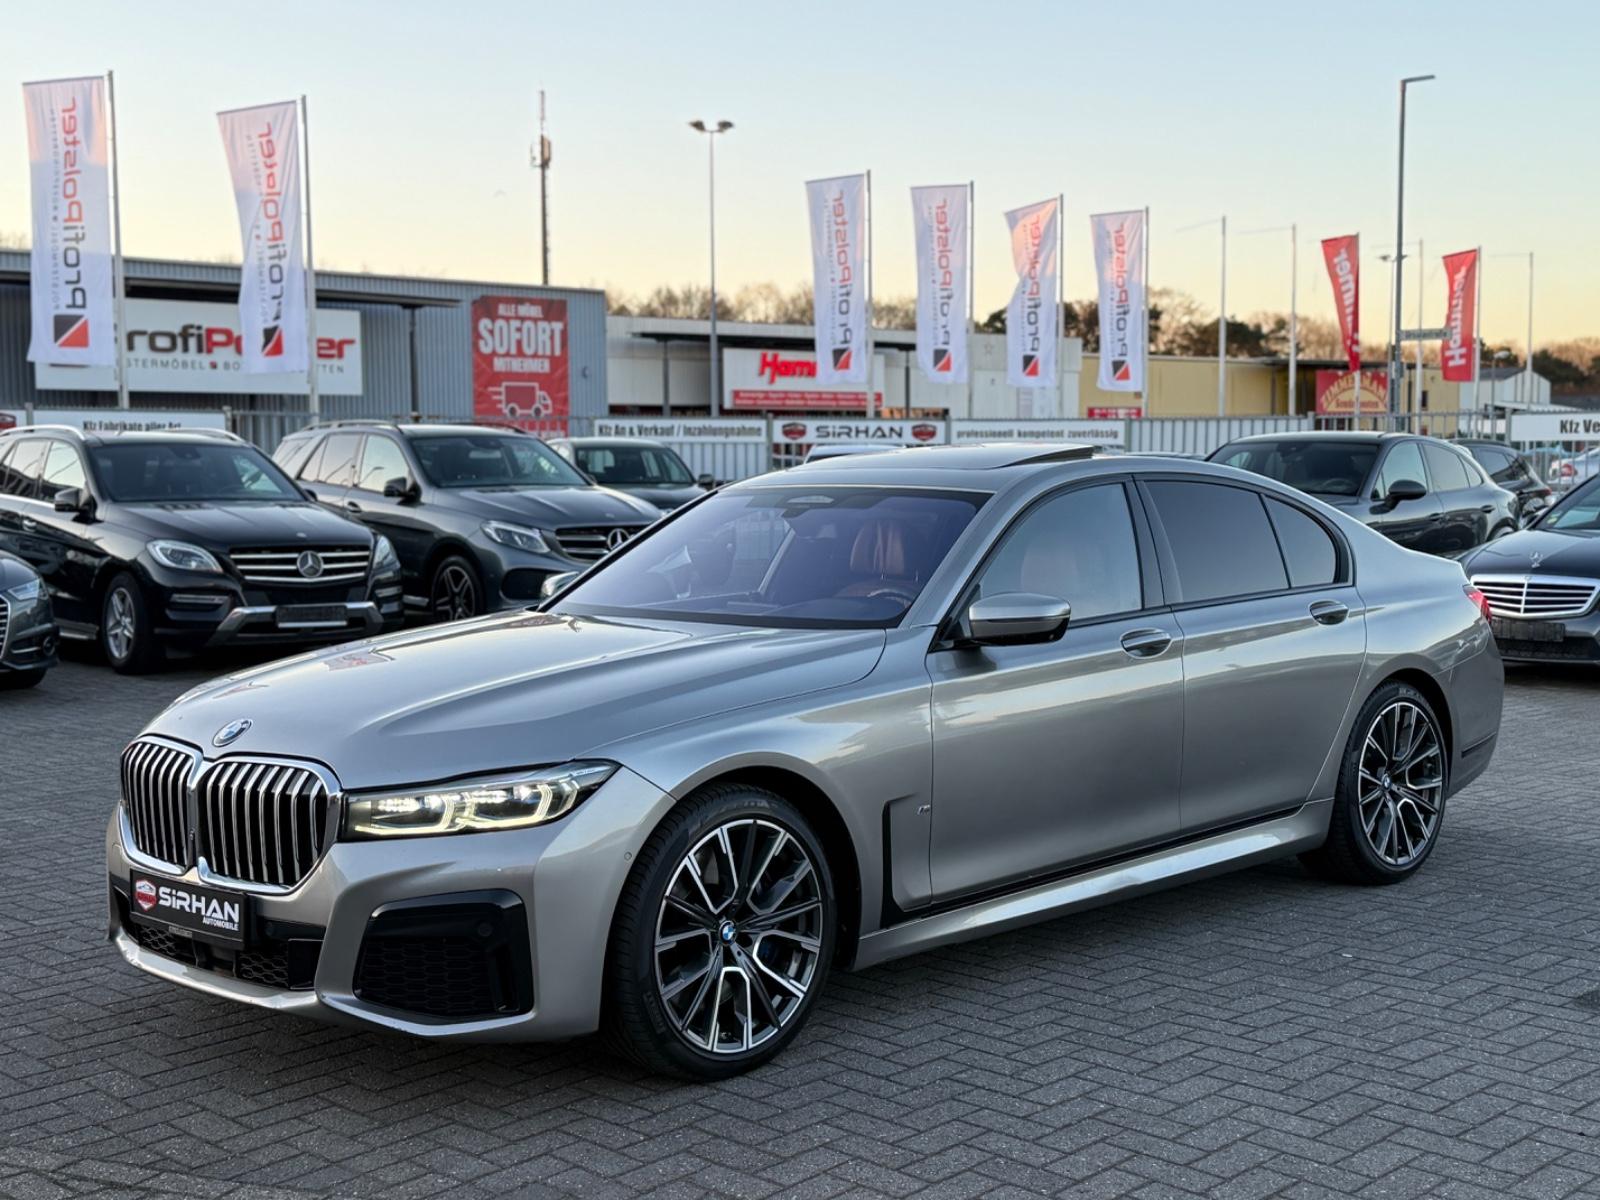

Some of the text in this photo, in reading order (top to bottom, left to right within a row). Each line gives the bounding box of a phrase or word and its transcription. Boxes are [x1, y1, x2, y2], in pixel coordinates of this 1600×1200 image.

[478, 317, 564, 356] SOFORT
[99, 420, 143, 432] Fabrikate
[637, 424, 675, 437] Verkauf
[1560, 419, 1580, 434] Kfz
[957, 427, 1119, 440] professionell kompetent zuverlässig
[203, 916, 239, 932] AUTOMOBILE
